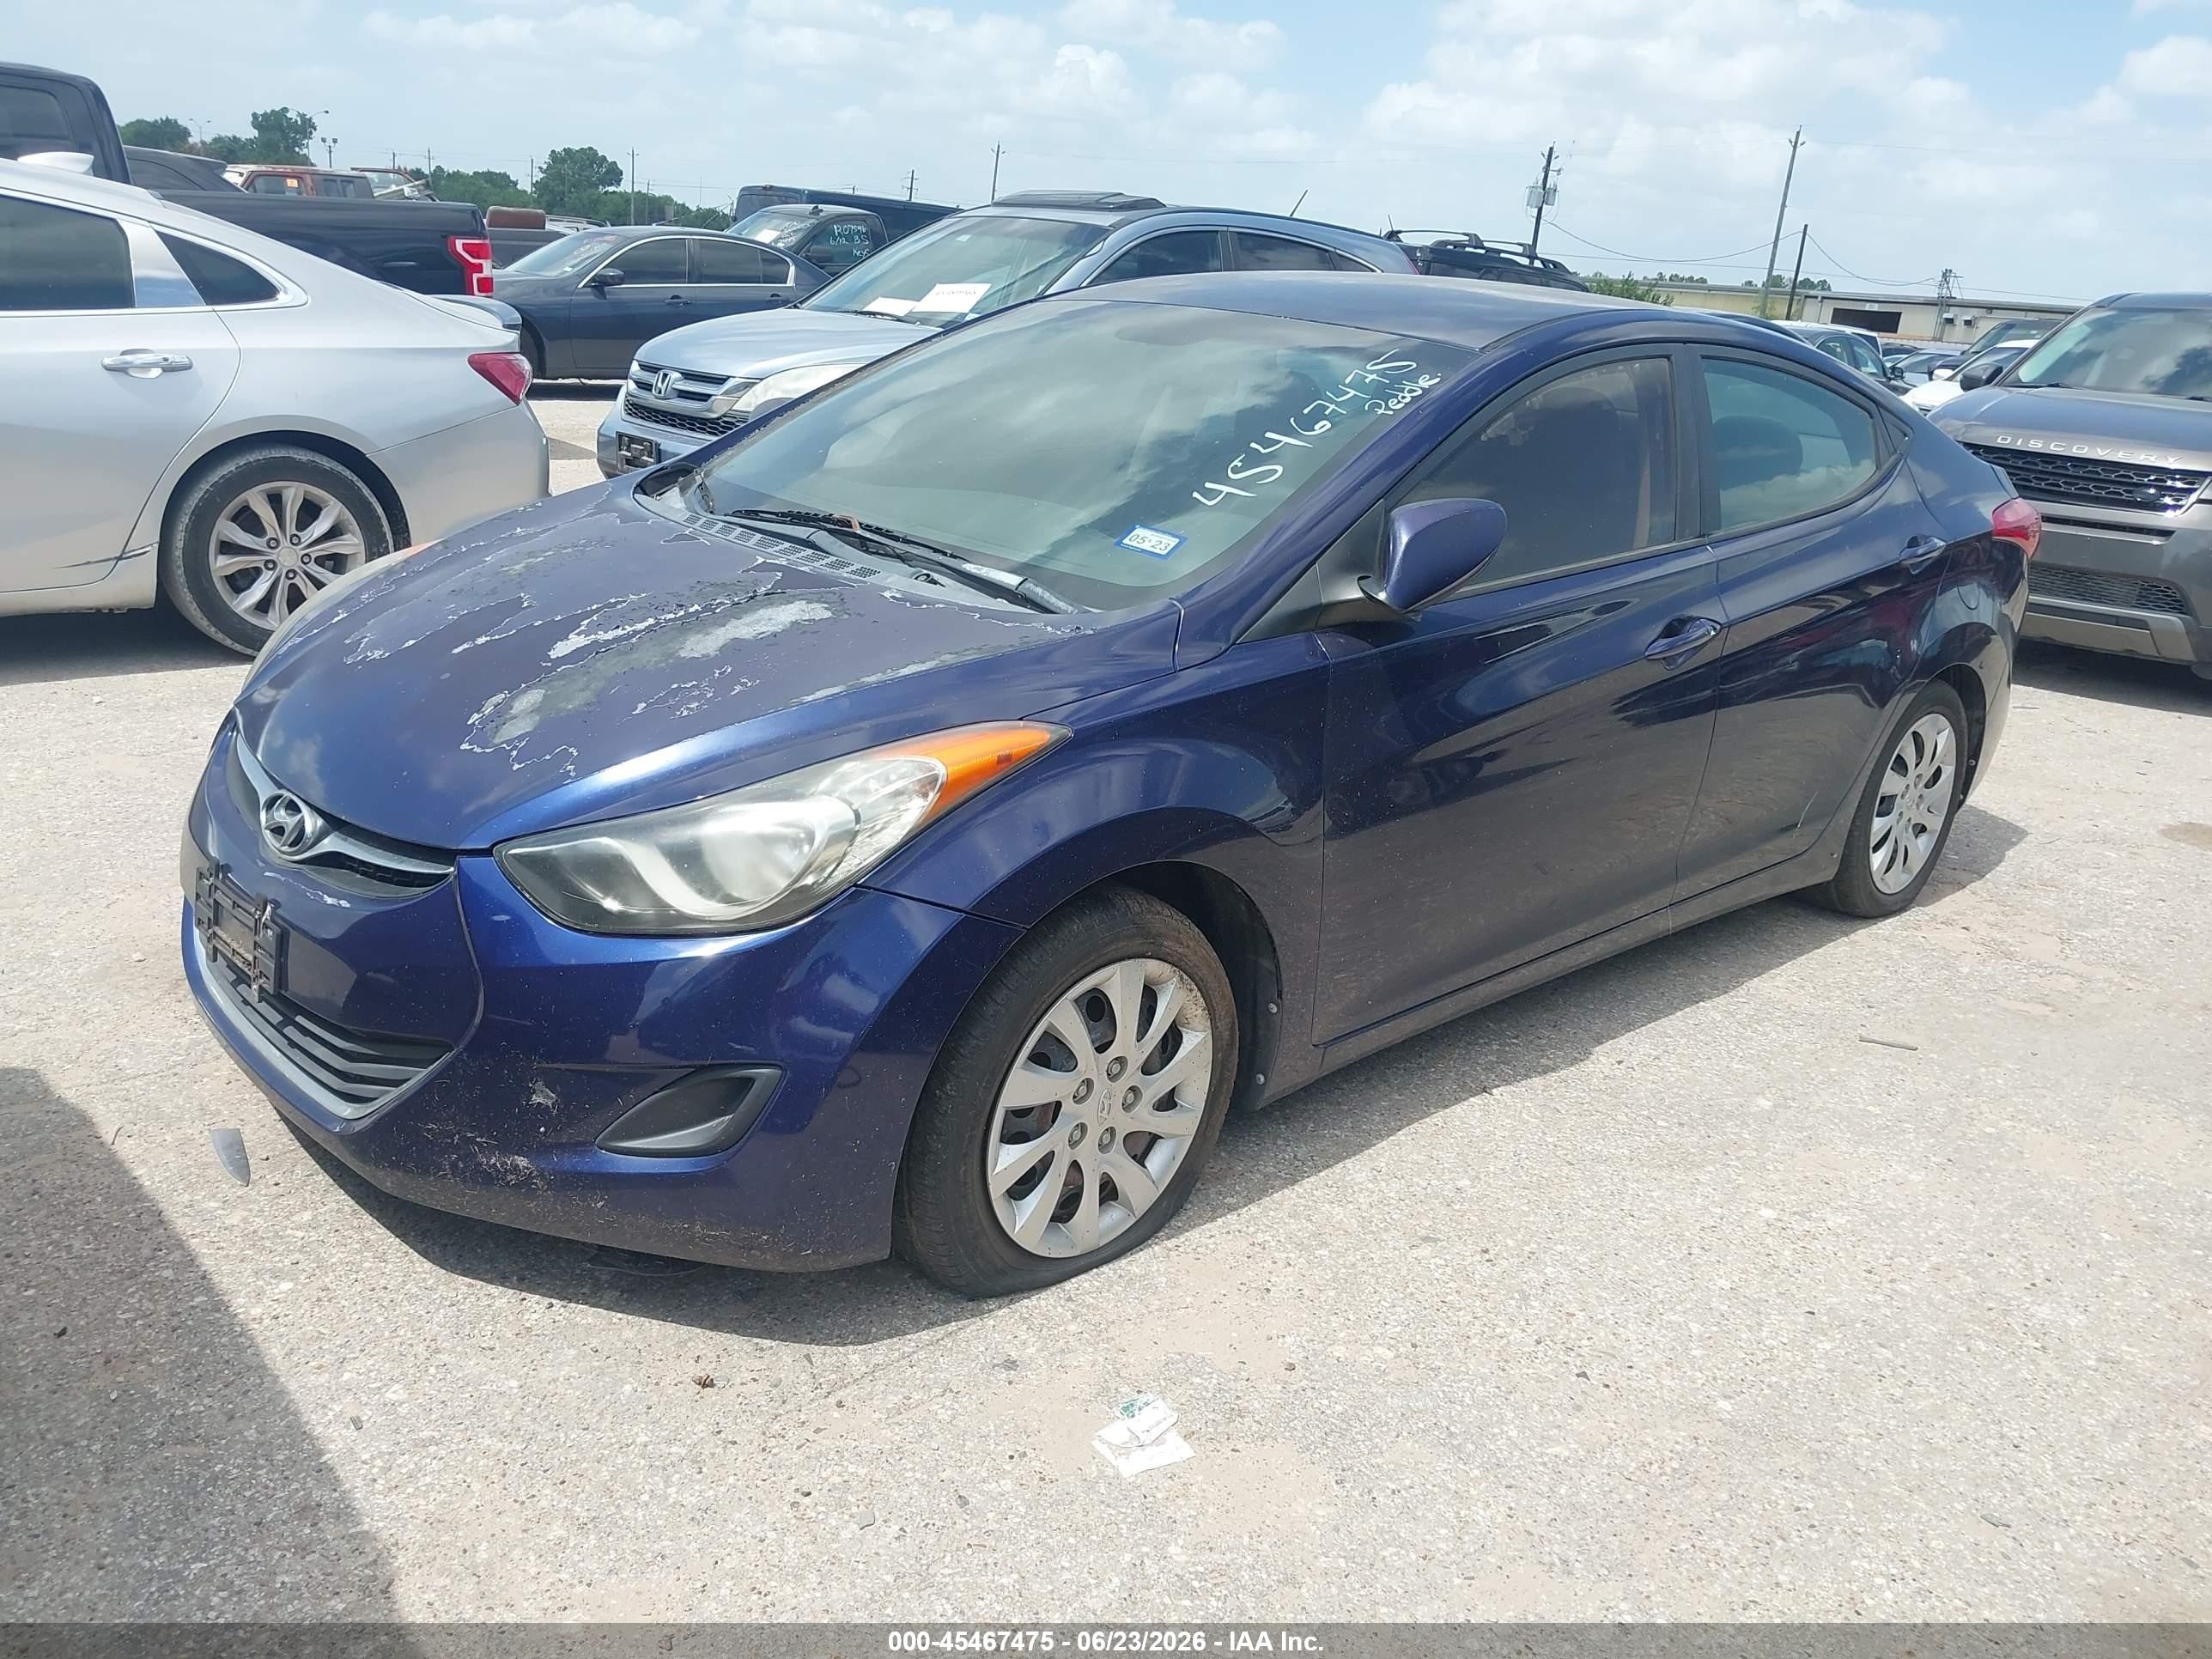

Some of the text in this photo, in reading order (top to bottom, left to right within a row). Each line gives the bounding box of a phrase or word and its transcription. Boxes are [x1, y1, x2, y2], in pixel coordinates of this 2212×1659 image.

[830, 236, 849, 246] 6/12
[1192, 349, 1417, 507] 45467475
[1996, 435, 2182, 464] DISCOVERY
[1128, 533, 1148, 544] 05
[1151, 539, 1170, 551] 23
